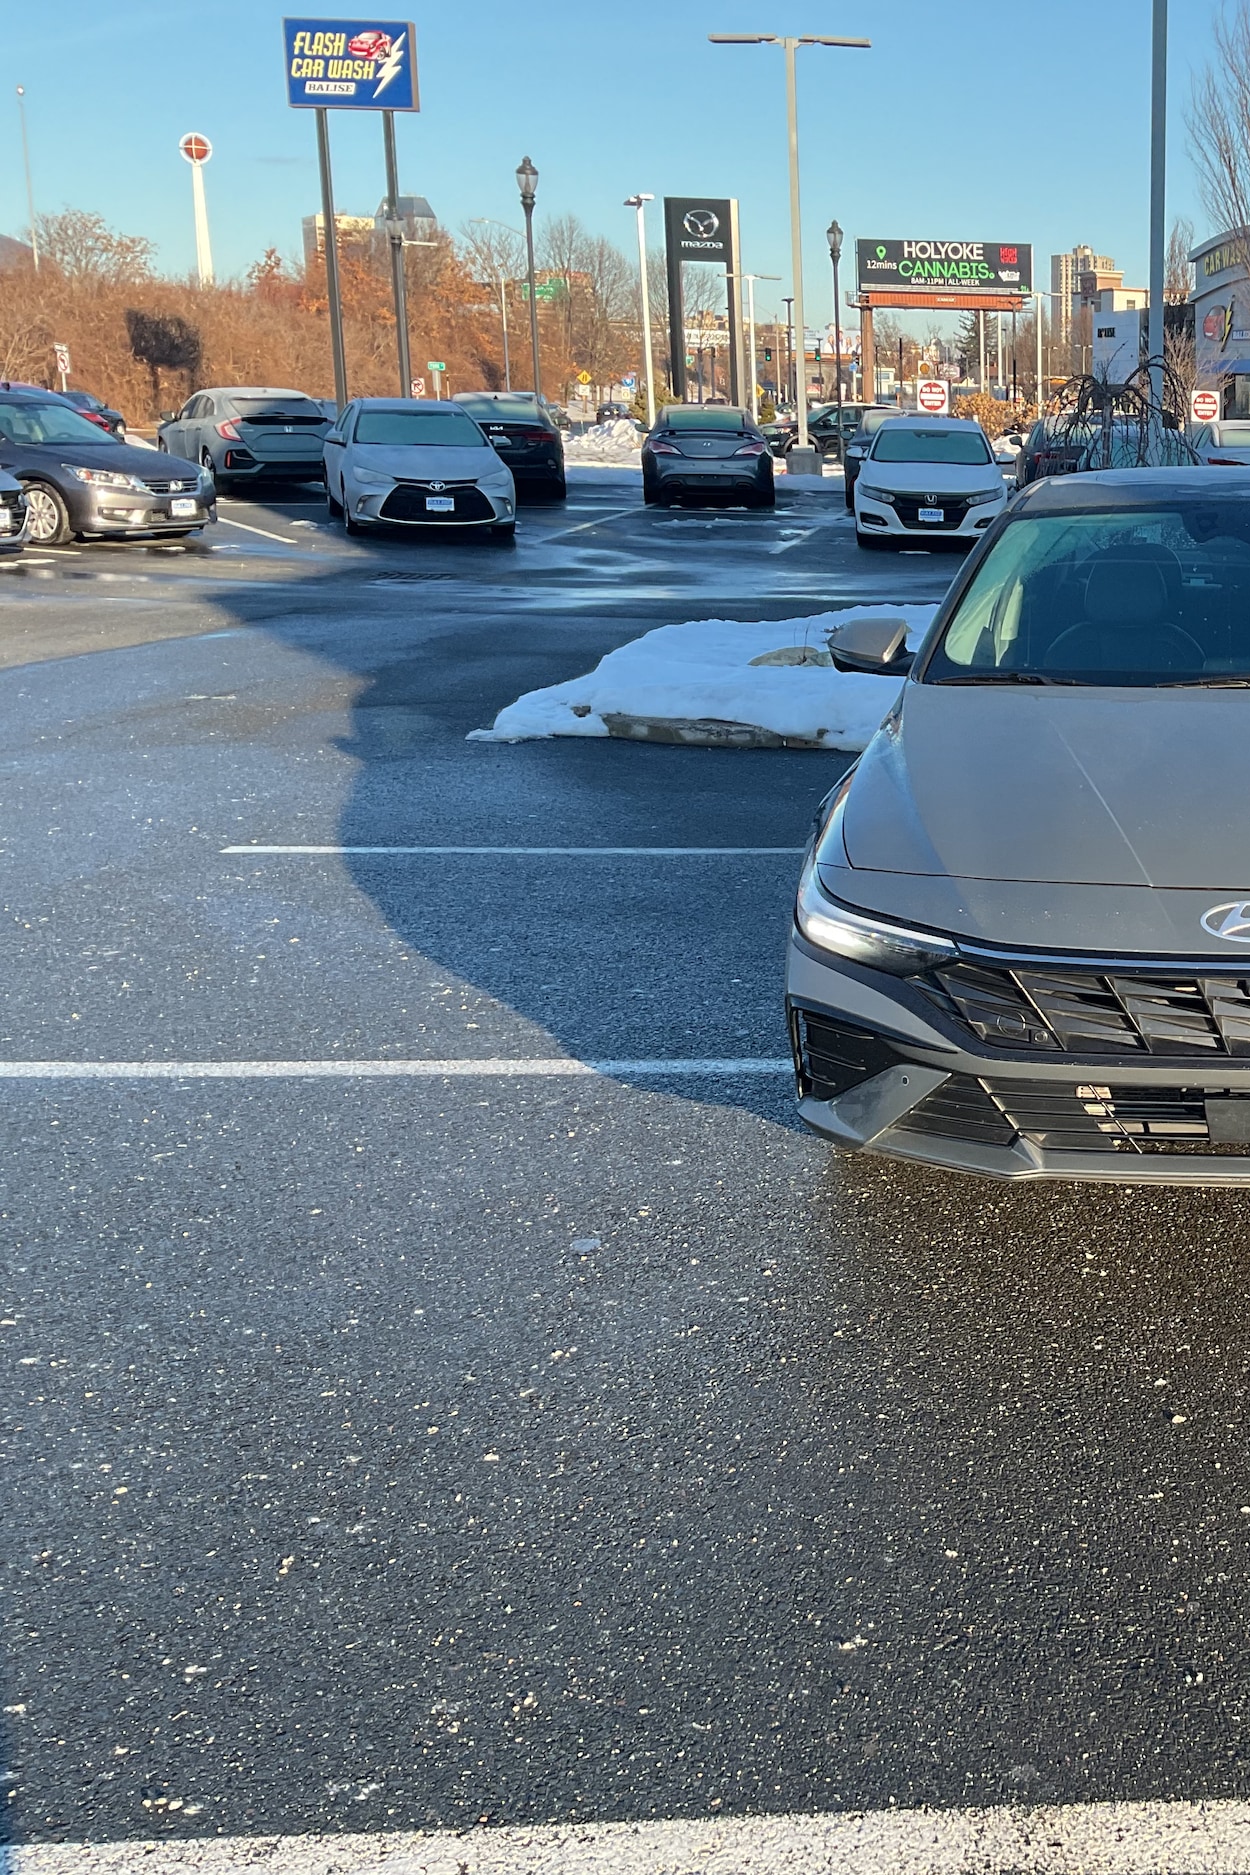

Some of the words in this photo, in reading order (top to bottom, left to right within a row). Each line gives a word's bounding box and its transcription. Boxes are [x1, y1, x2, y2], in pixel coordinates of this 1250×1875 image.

[294, 32, 346, 56] FLASH
[291, 58, 325, 78] CAR
[327, 59, 375, 79] WASH
[307, 83, 354, 93] BALISE
[903, 241, 984, 260] HOLYOKE
[866, 260, 897, 270] 12mins
[1204, 250, 1220, 275] CAR
[911, 277, 944, 285] 8AM-11PM
[947, 278, 980, 286] ALL-WEEK
